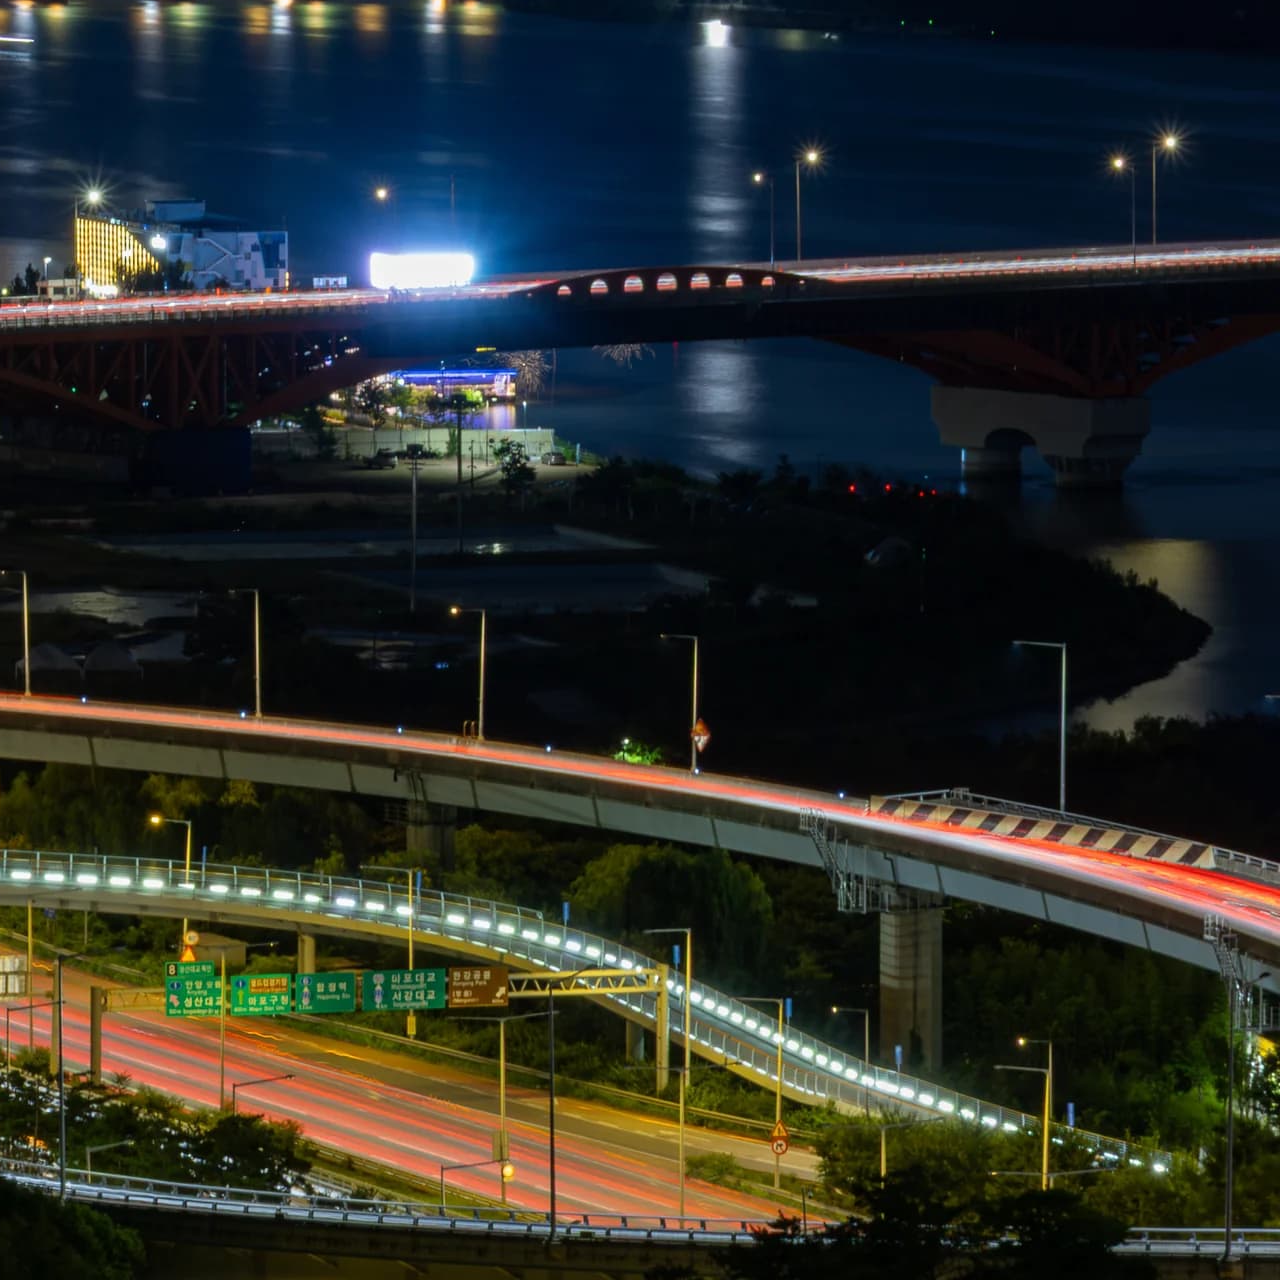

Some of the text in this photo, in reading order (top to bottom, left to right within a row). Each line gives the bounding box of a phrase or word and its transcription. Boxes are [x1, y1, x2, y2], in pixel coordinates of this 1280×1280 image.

[168, 964, 176, 975] 8
[391, 972, 436, 983] 마포대교
[453, 970, 491, 981] 한강공원
[248, 995, 289, 1006] 마포구청
[391, 989, 436, 1001] 서강대교
